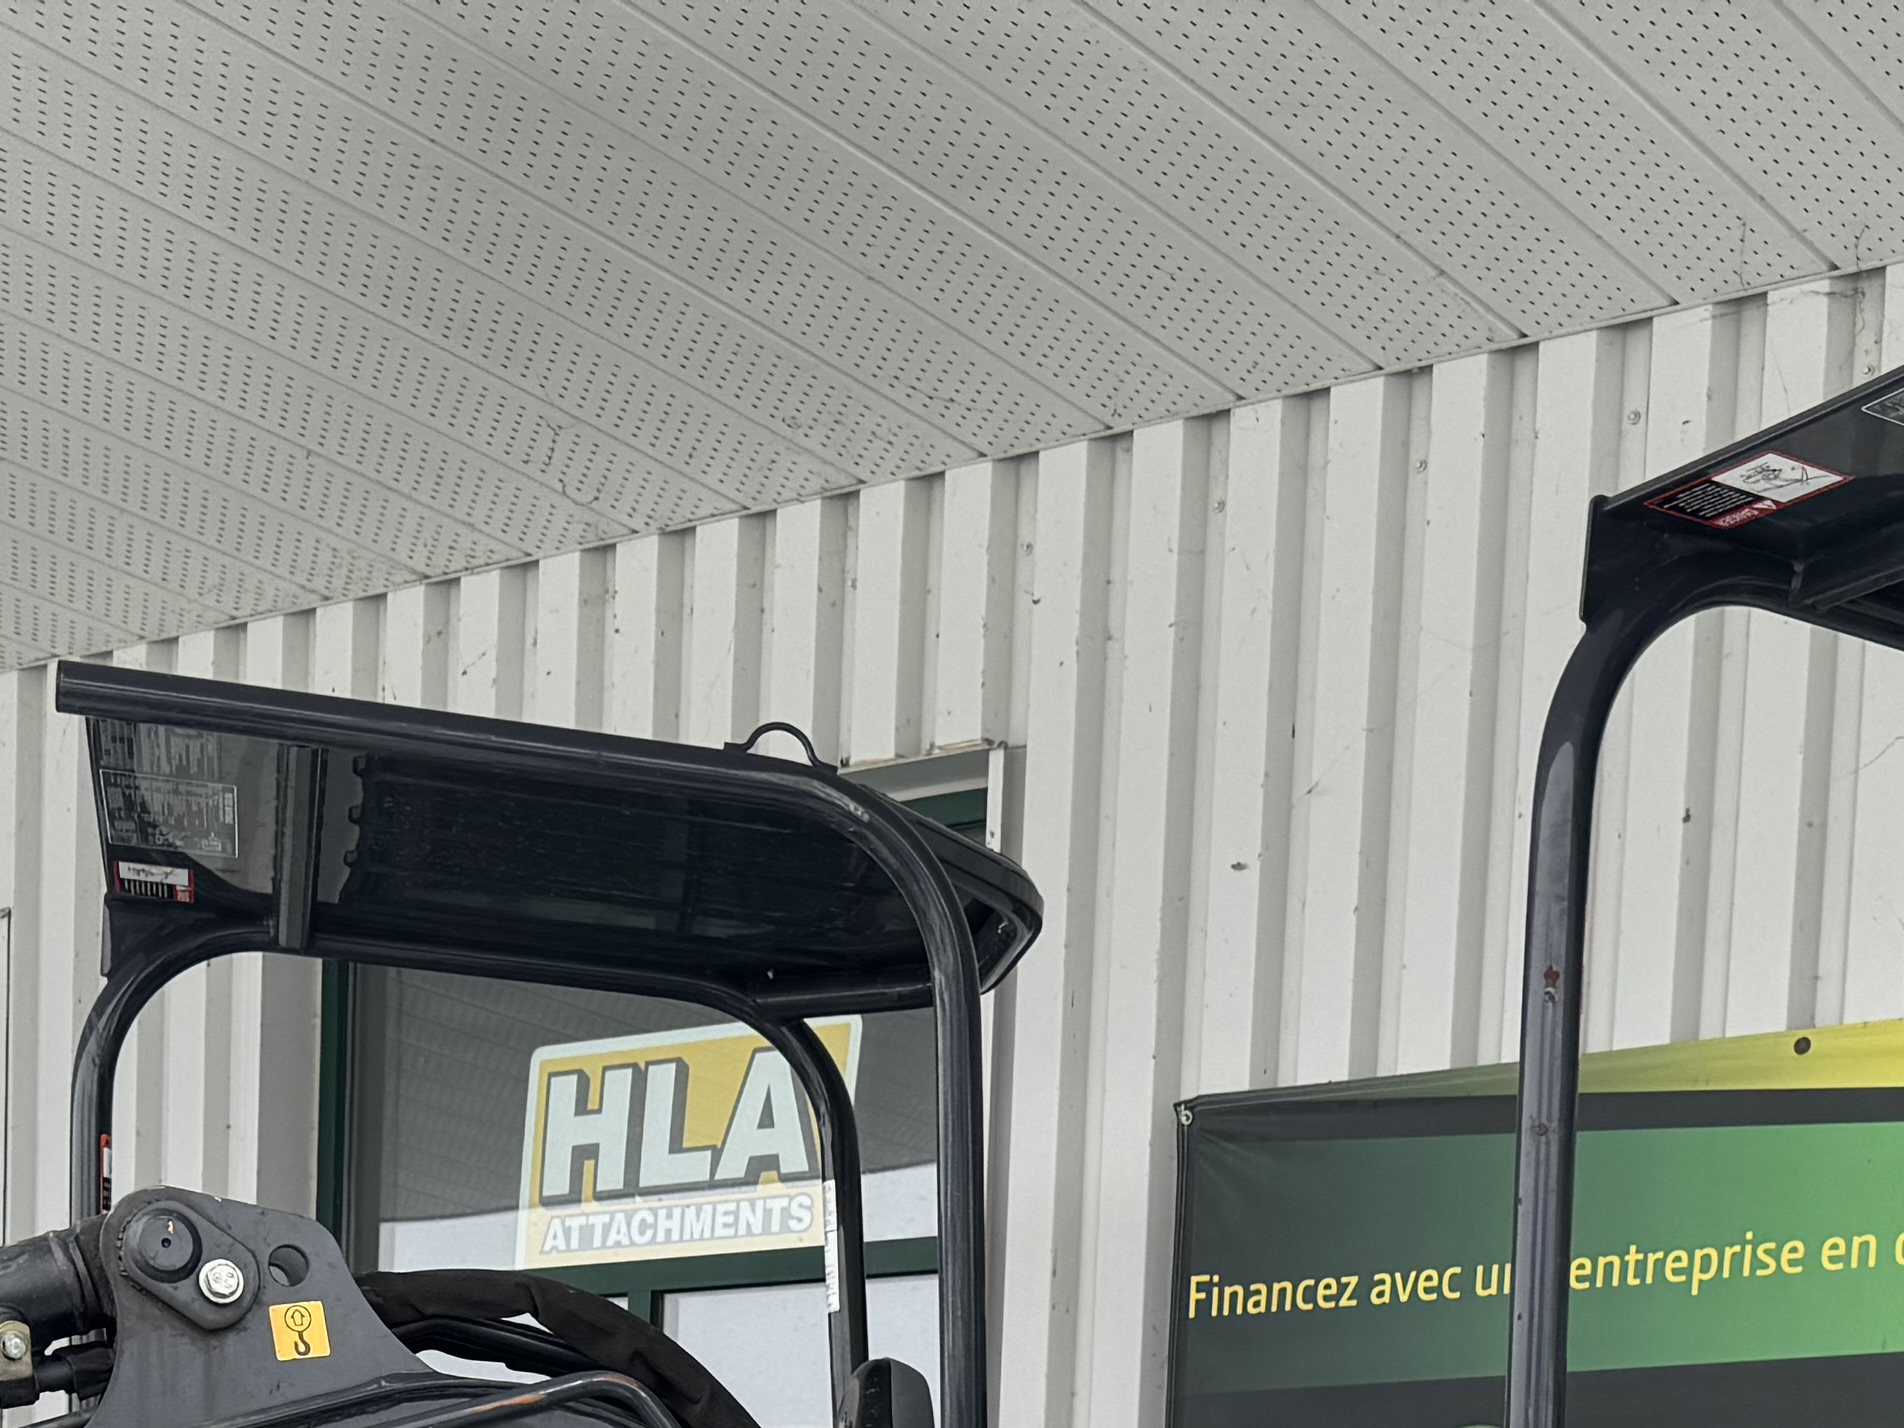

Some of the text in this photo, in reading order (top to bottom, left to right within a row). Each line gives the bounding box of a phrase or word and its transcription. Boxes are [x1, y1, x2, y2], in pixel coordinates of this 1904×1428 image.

[541, 1048, 814, 1202] HLA
[542, 1193, 814, 1253] ATTACHMENTS
[1188, 1273, 1359, 1319] Financez
[1370, 1266, 1462, 1305] avec
[1569, 1231, 1805, 1296] entreprise
[1821, 1233, 1877, 1271] en
